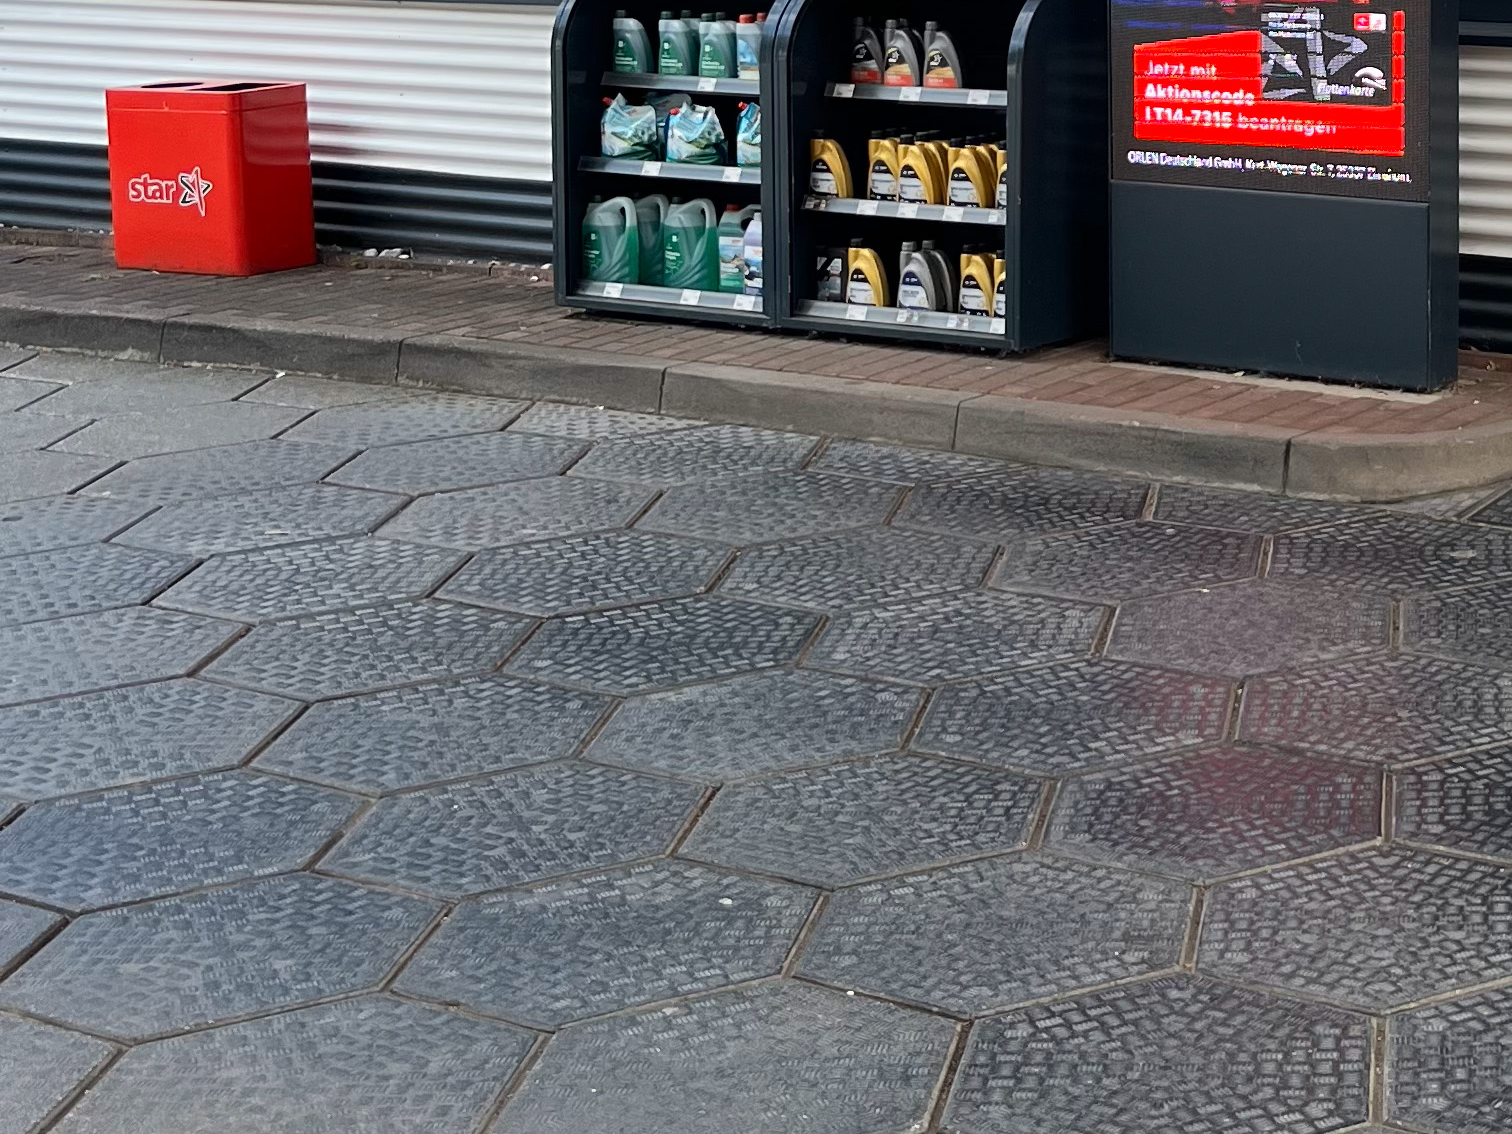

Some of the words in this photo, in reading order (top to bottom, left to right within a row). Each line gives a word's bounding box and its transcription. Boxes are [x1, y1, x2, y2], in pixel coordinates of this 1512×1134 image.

[1144, 60, 1186, 76] Jetzt
[1190, 63, 1217, 77] mit
[1145, 82, 1255, 106] Aktionscode
[129, 173, 177, 204] star
